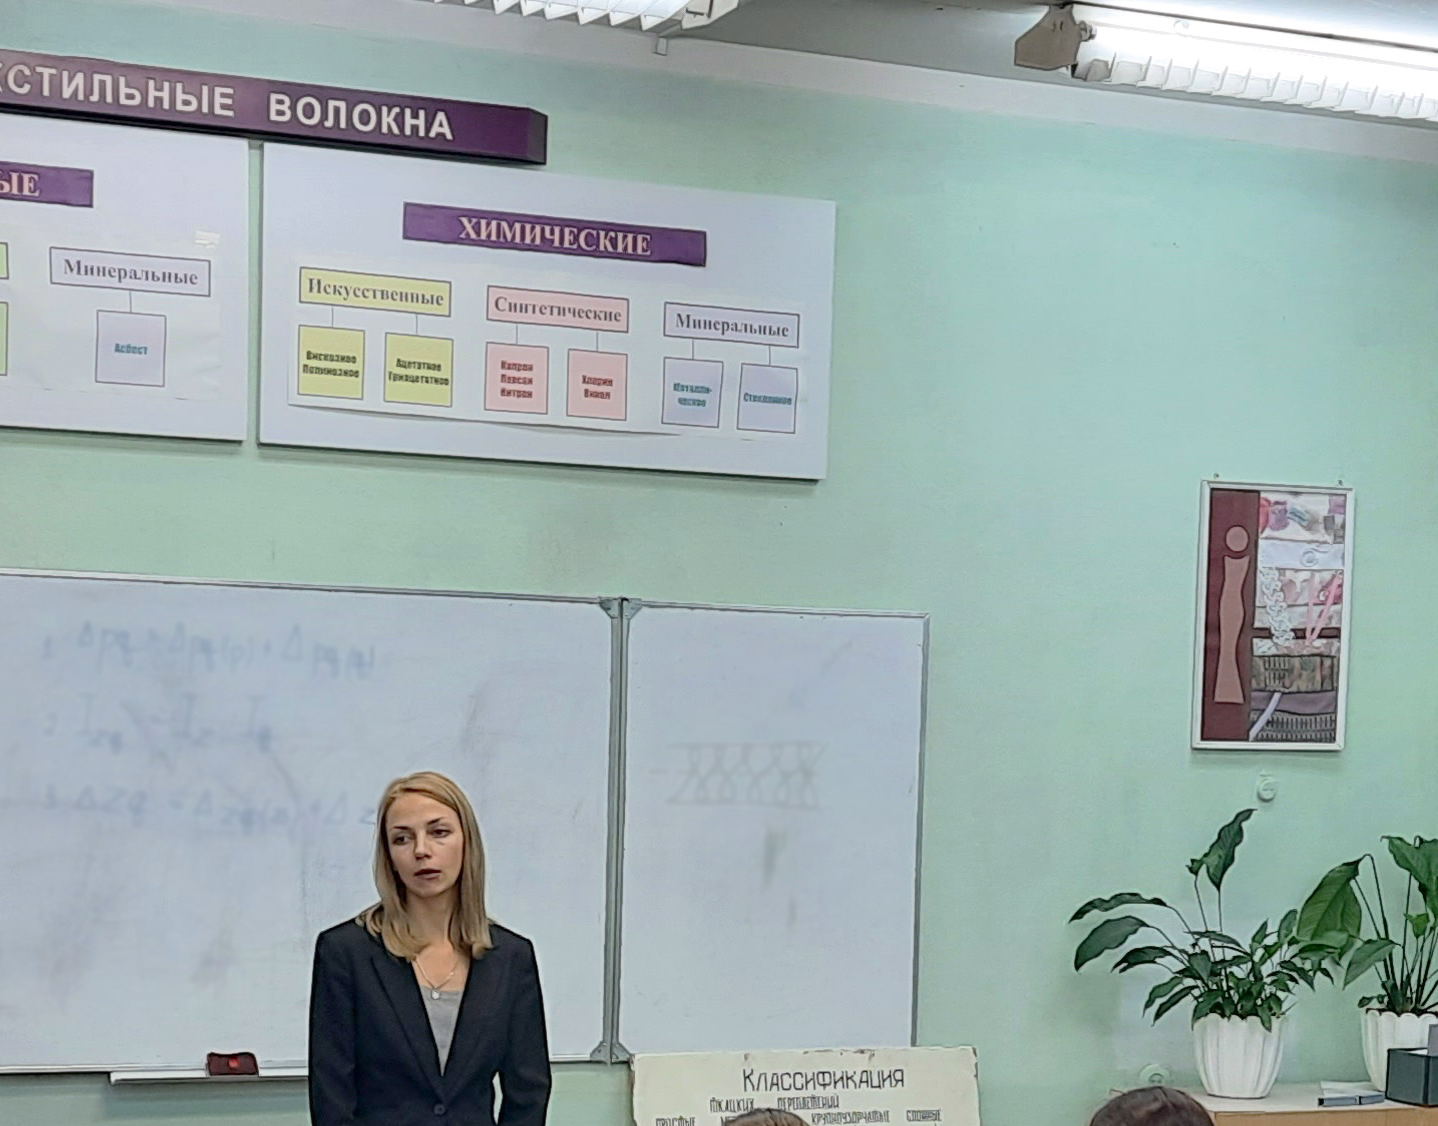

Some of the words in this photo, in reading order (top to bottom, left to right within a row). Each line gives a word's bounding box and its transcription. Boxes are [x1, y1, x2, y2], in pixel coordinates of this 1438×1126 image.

[269, 94, 454, 141] ВОЛОКНА
[460, 216, 651, 256] ХИМИЧЕСКИЕ
[63, 259, 198, 286] Минеральные
[308, 278, 444, 306] Искусственные
[494, 296, 622, 323] Синтетические
[675, 313, 789, 337] Минеральные
[114, 343, 148, 355] Асбест
[396, 358, 441, 372] Ацетатное
[742, 1068, 905, 1093] КЛАССИФИКАЦИЯ
